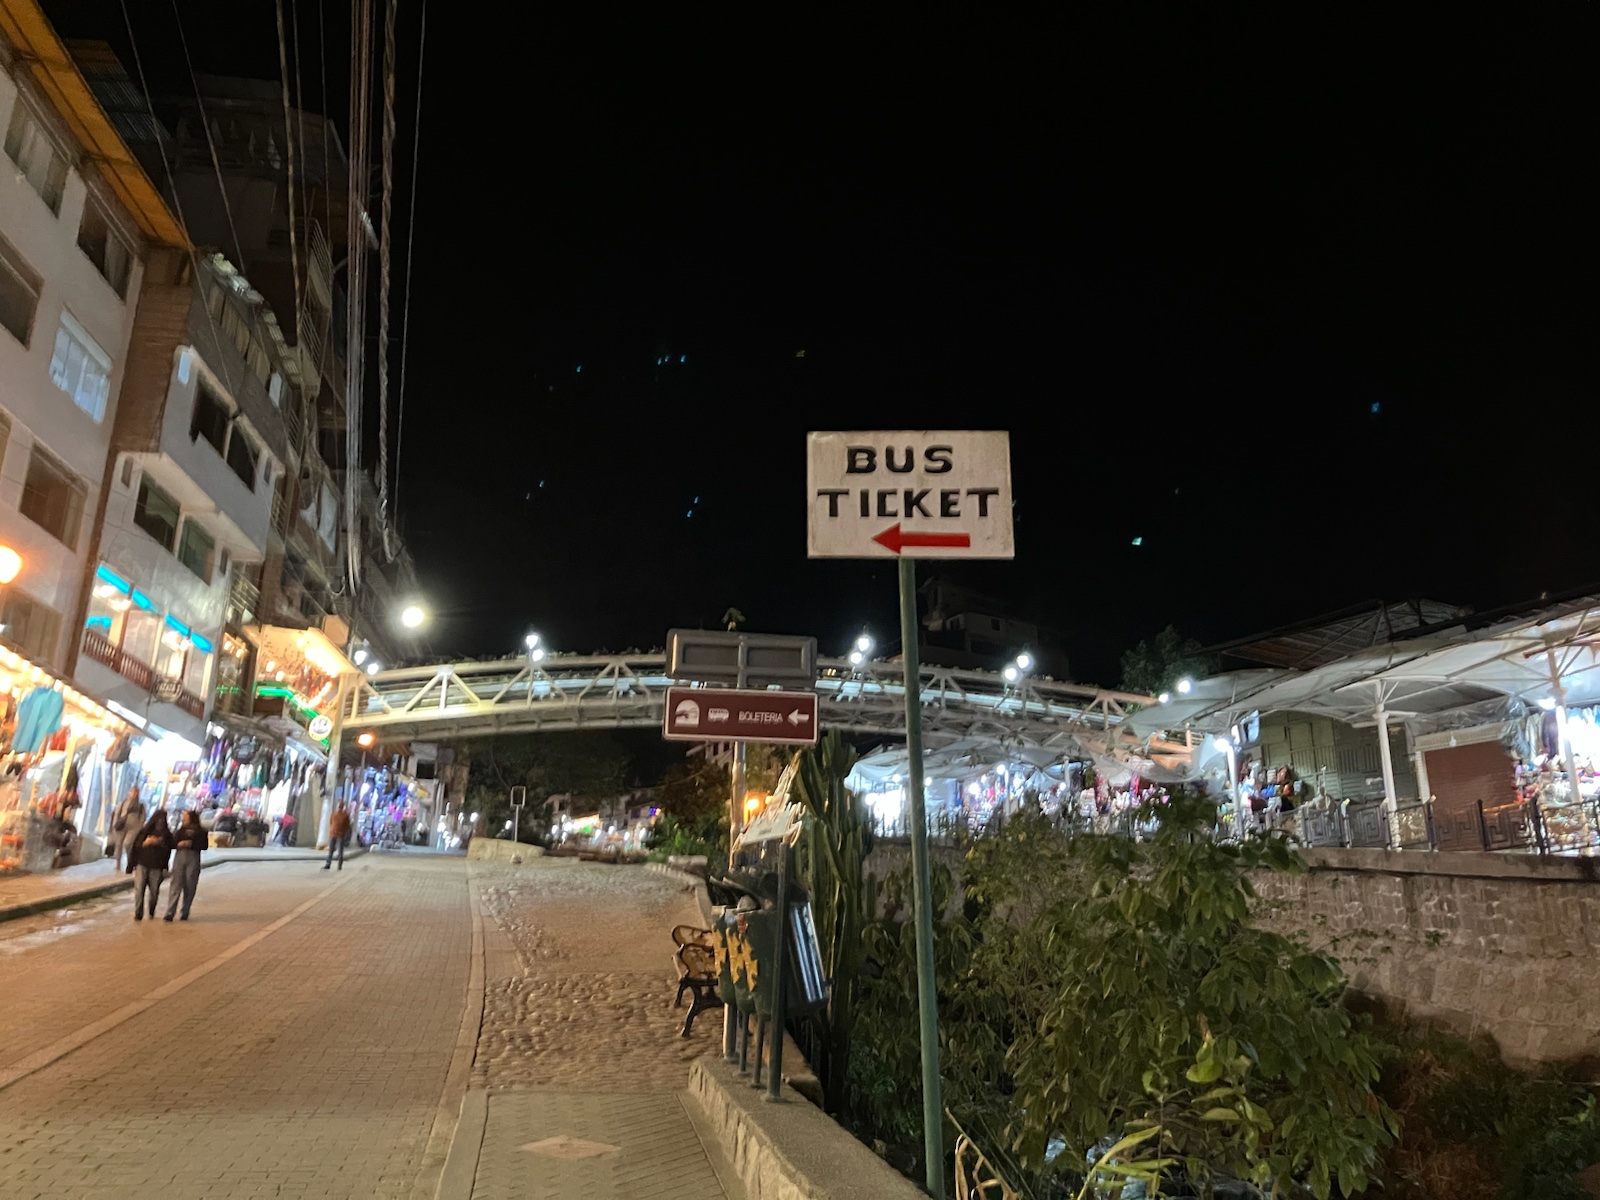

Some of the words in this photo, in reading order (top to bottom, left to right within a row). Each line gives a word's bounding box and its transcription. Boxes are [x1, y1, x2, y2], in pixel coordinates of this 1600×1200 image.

[846, 445, 953, 474] BUS
[817, 487, 999, 518] TICKET
[738, 710, 783, 725] BOLETERIA
